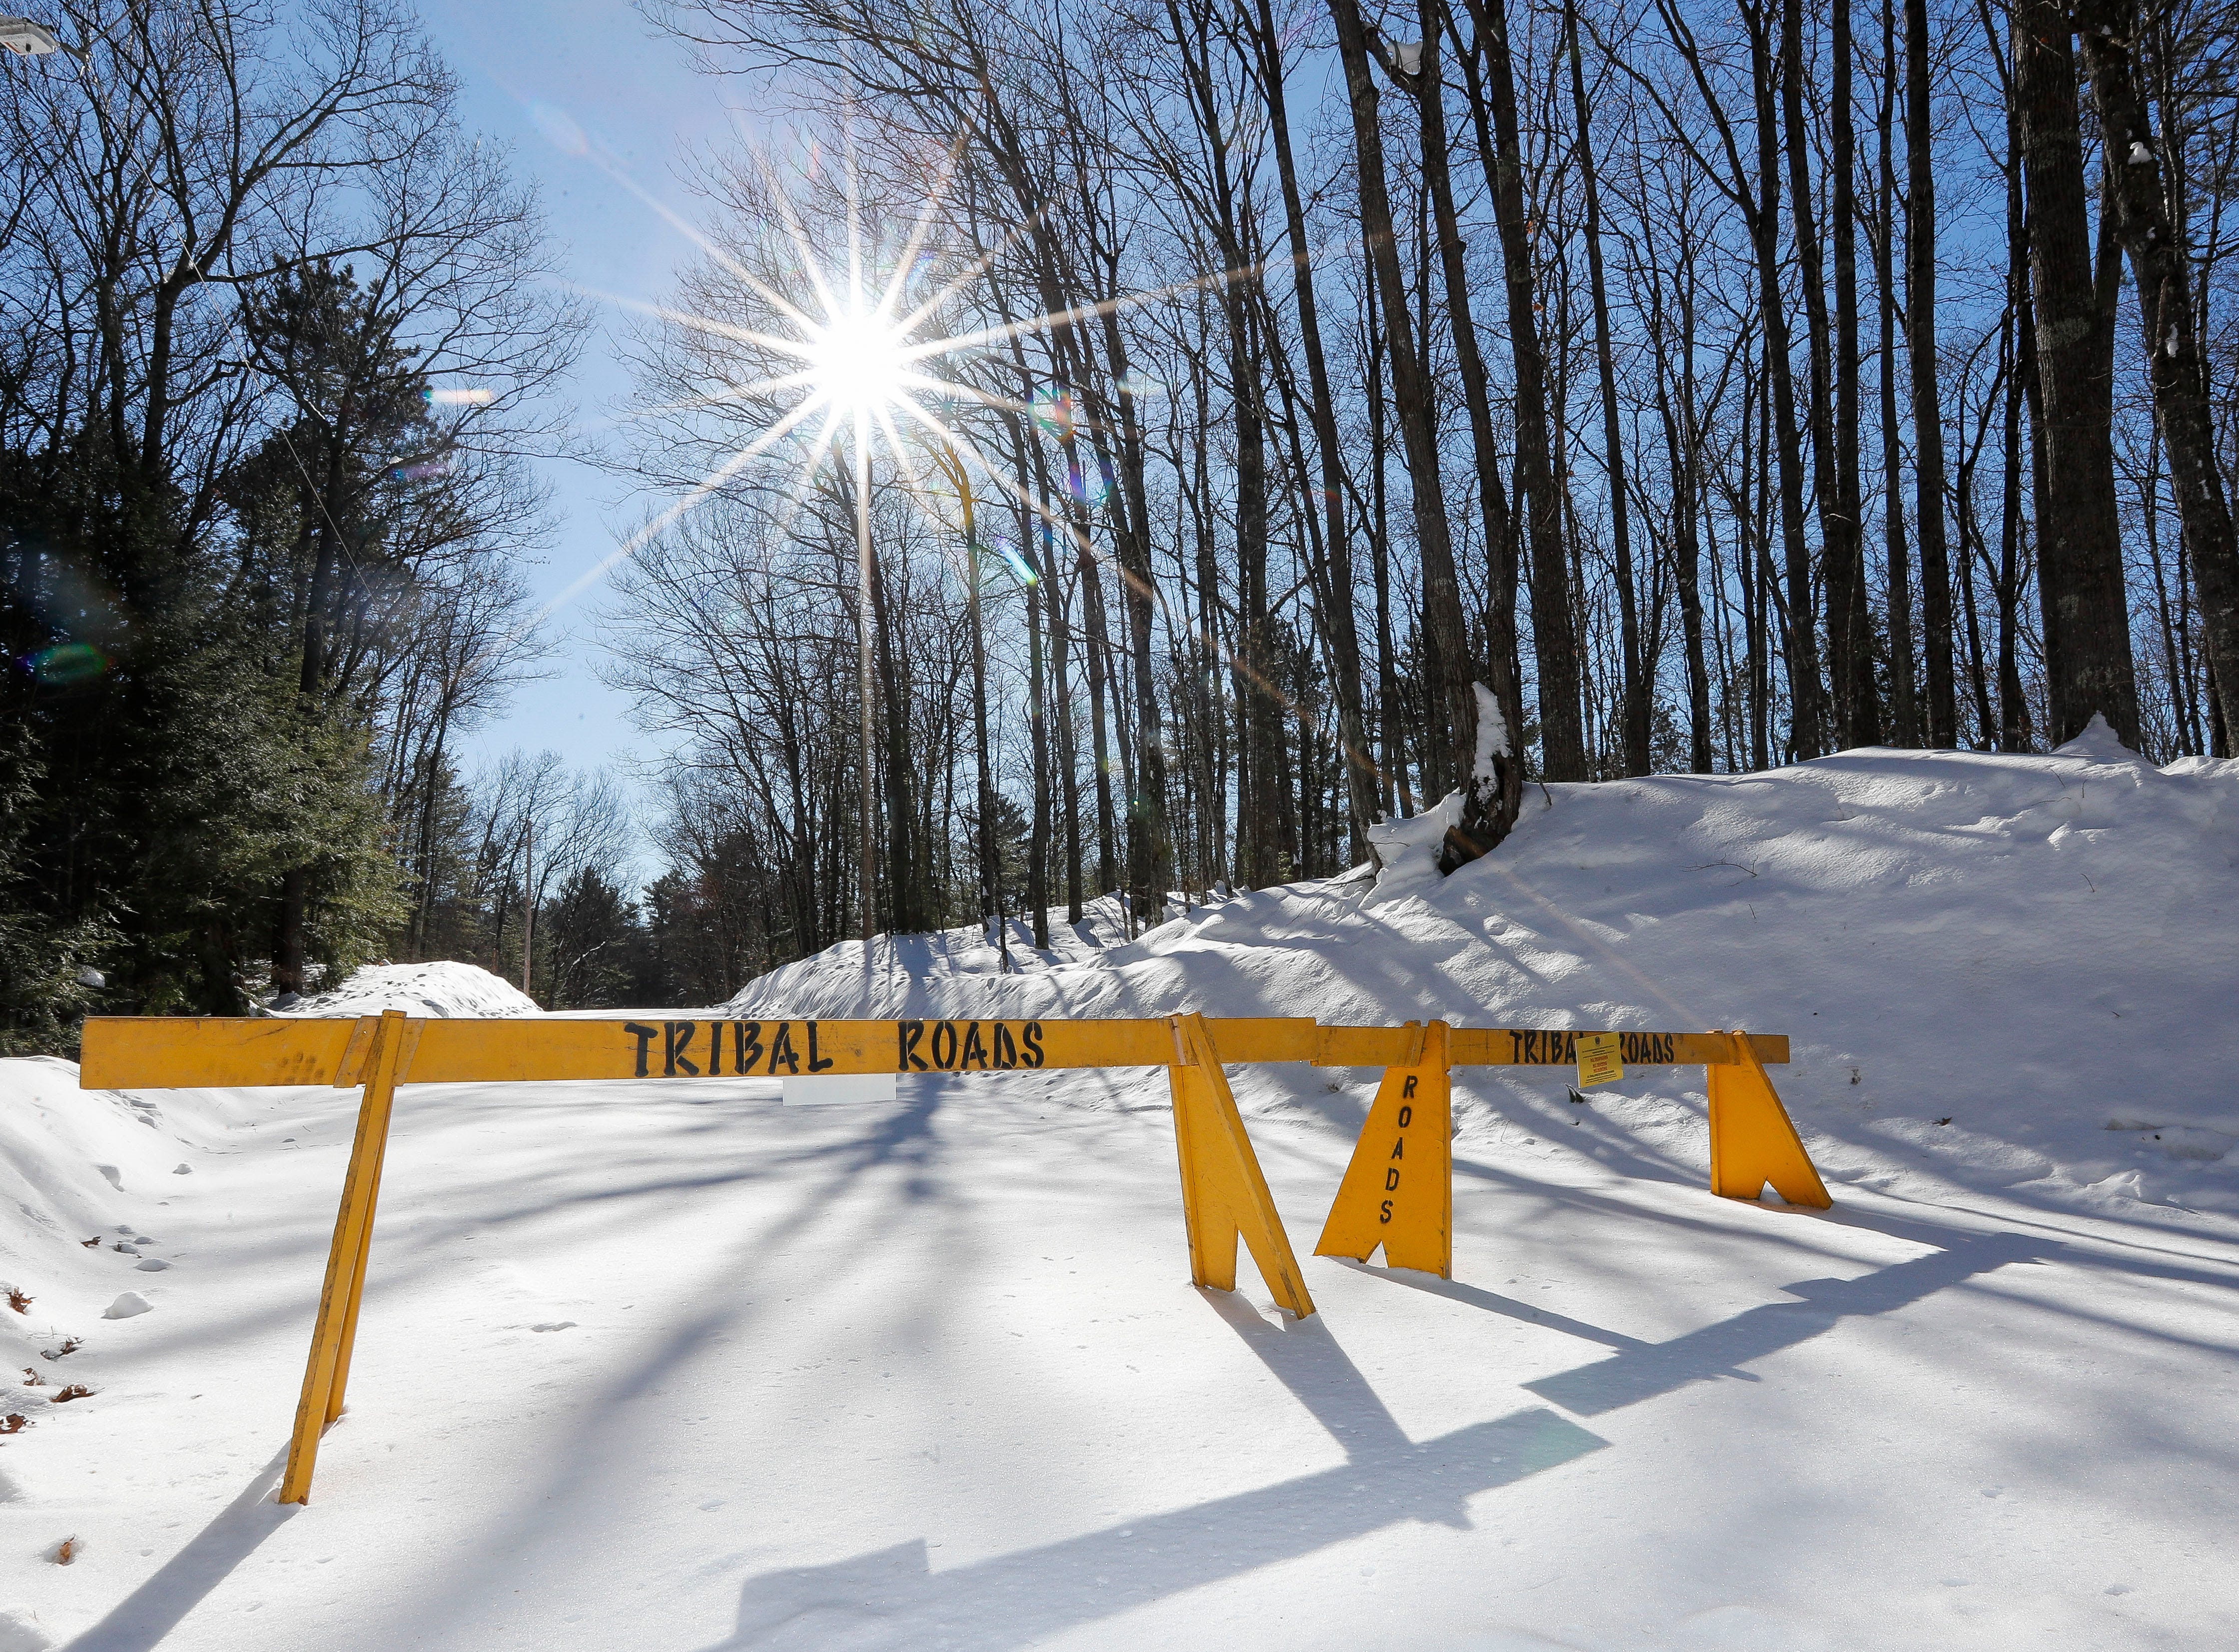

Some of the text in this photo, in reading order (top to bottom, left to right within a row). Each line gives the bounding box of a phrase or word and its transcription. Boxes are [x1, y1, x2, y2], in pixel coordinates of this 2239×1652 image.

[624, 1021, 1044, 1077] TRIBAL ROADS
[1509, 1030, 1584, 1063] TRIBA
[1380, 1075, 1418, 1224] ROADS
